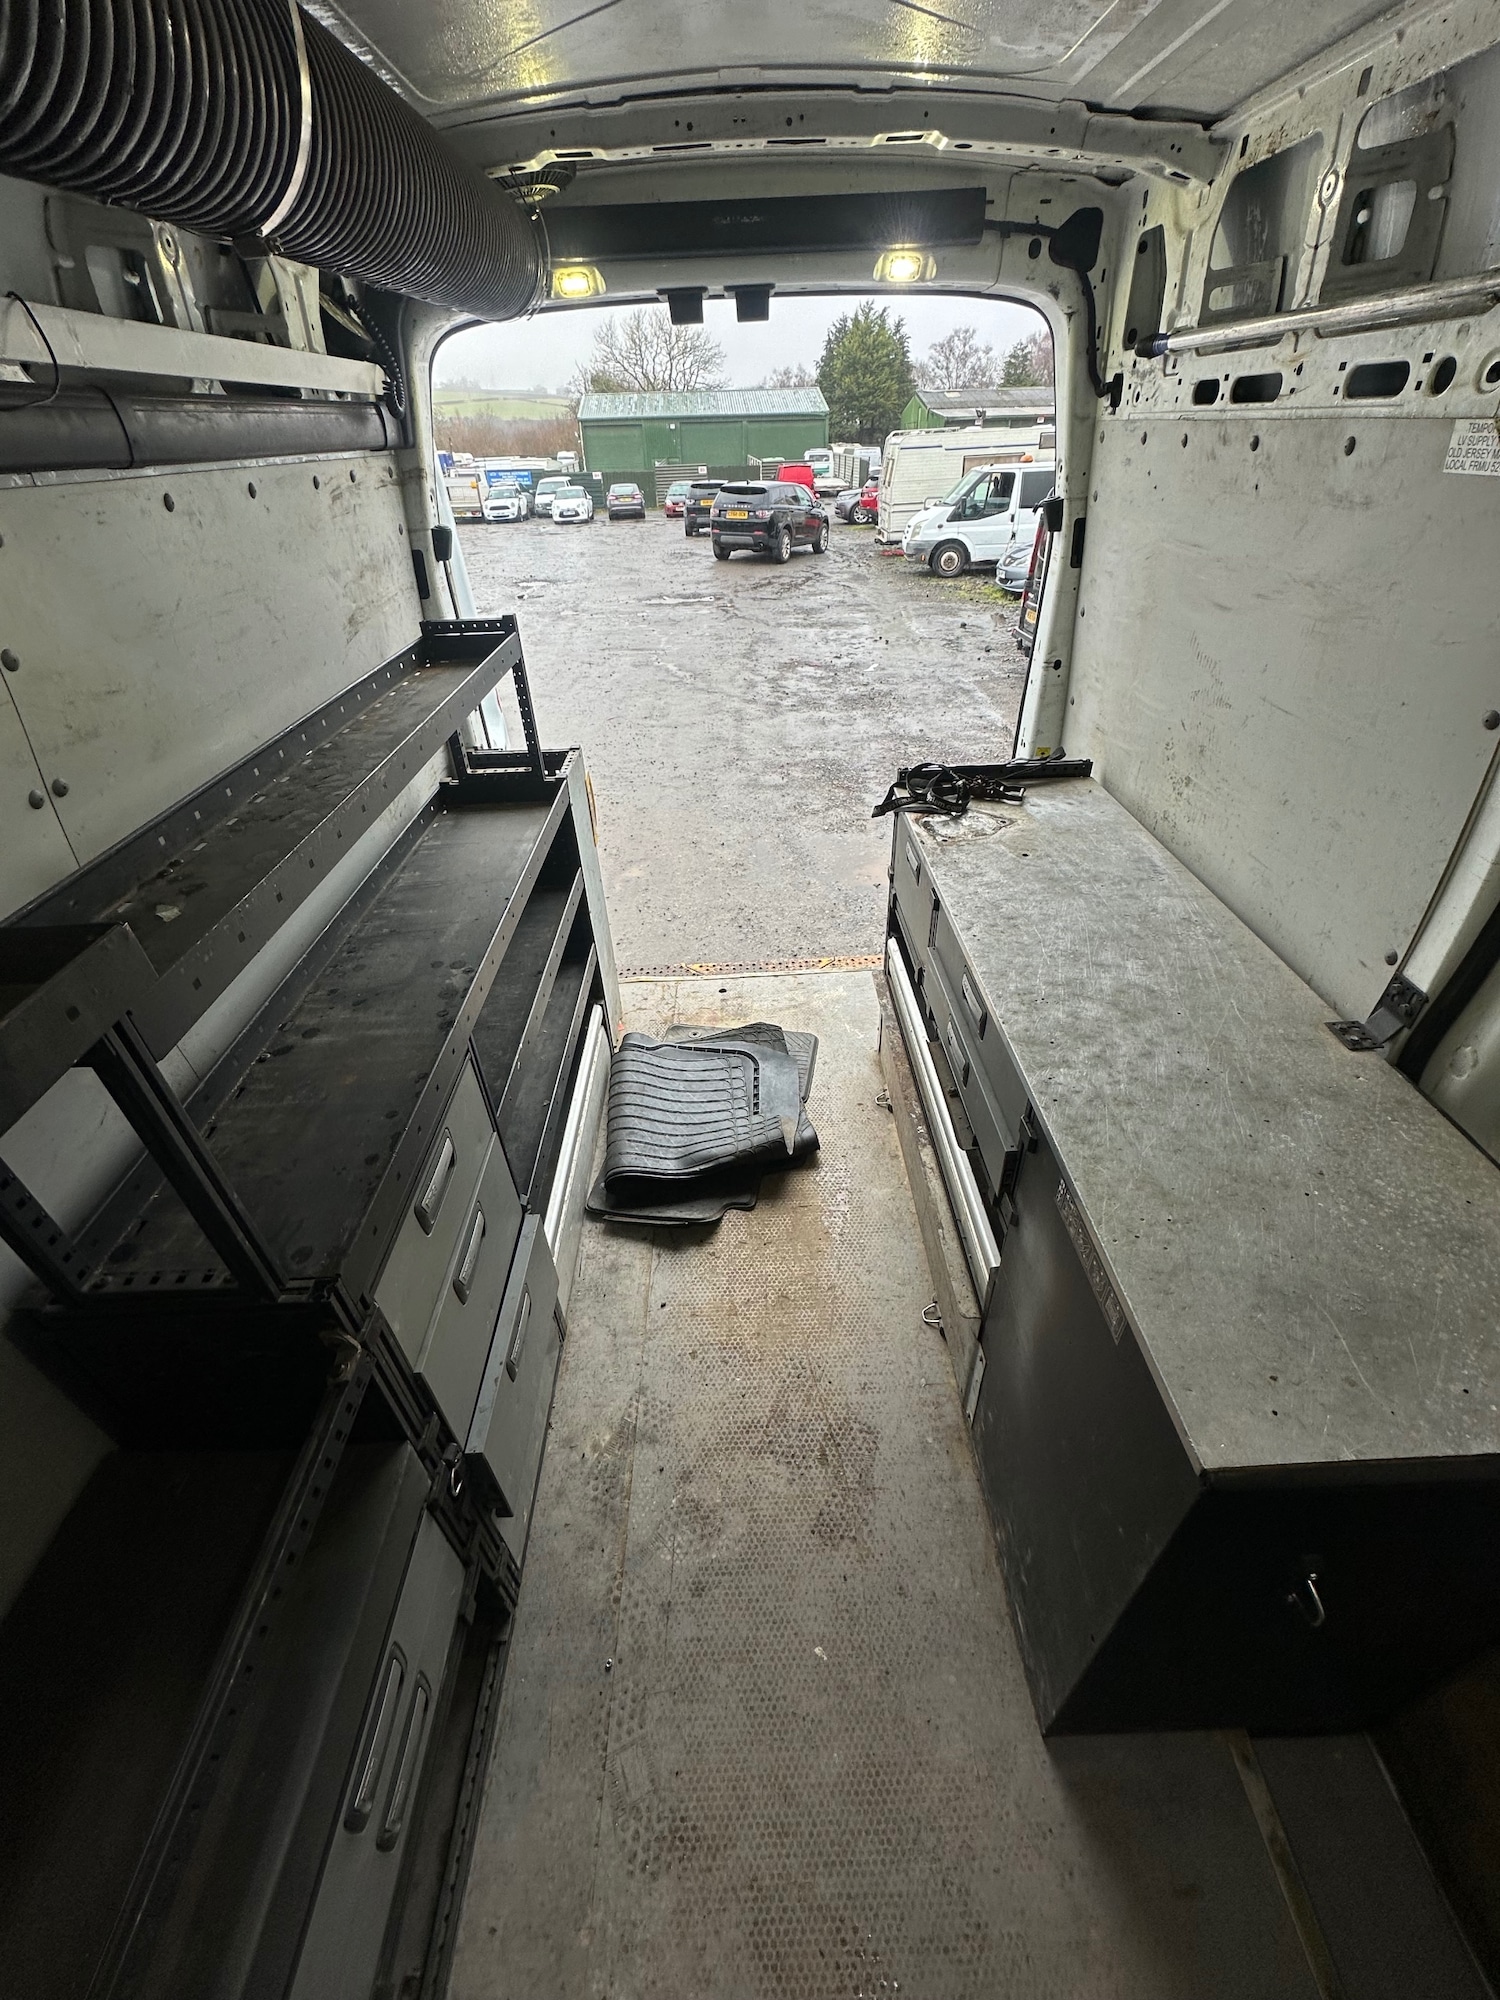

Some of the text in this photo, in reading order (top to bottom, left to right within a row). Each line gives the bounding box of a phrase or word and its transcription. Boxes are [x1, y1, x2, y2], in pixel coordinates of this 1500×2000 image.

[1468, 422, 1495, 433] TEMPO
[1457, 435, 1497, 447] LV SUPPLY
[1447, 447, 1463, 458] OLD
[1462, 448, 1492, 459] JERSEY
[1445, 459, 1467, 471] LOCAL
